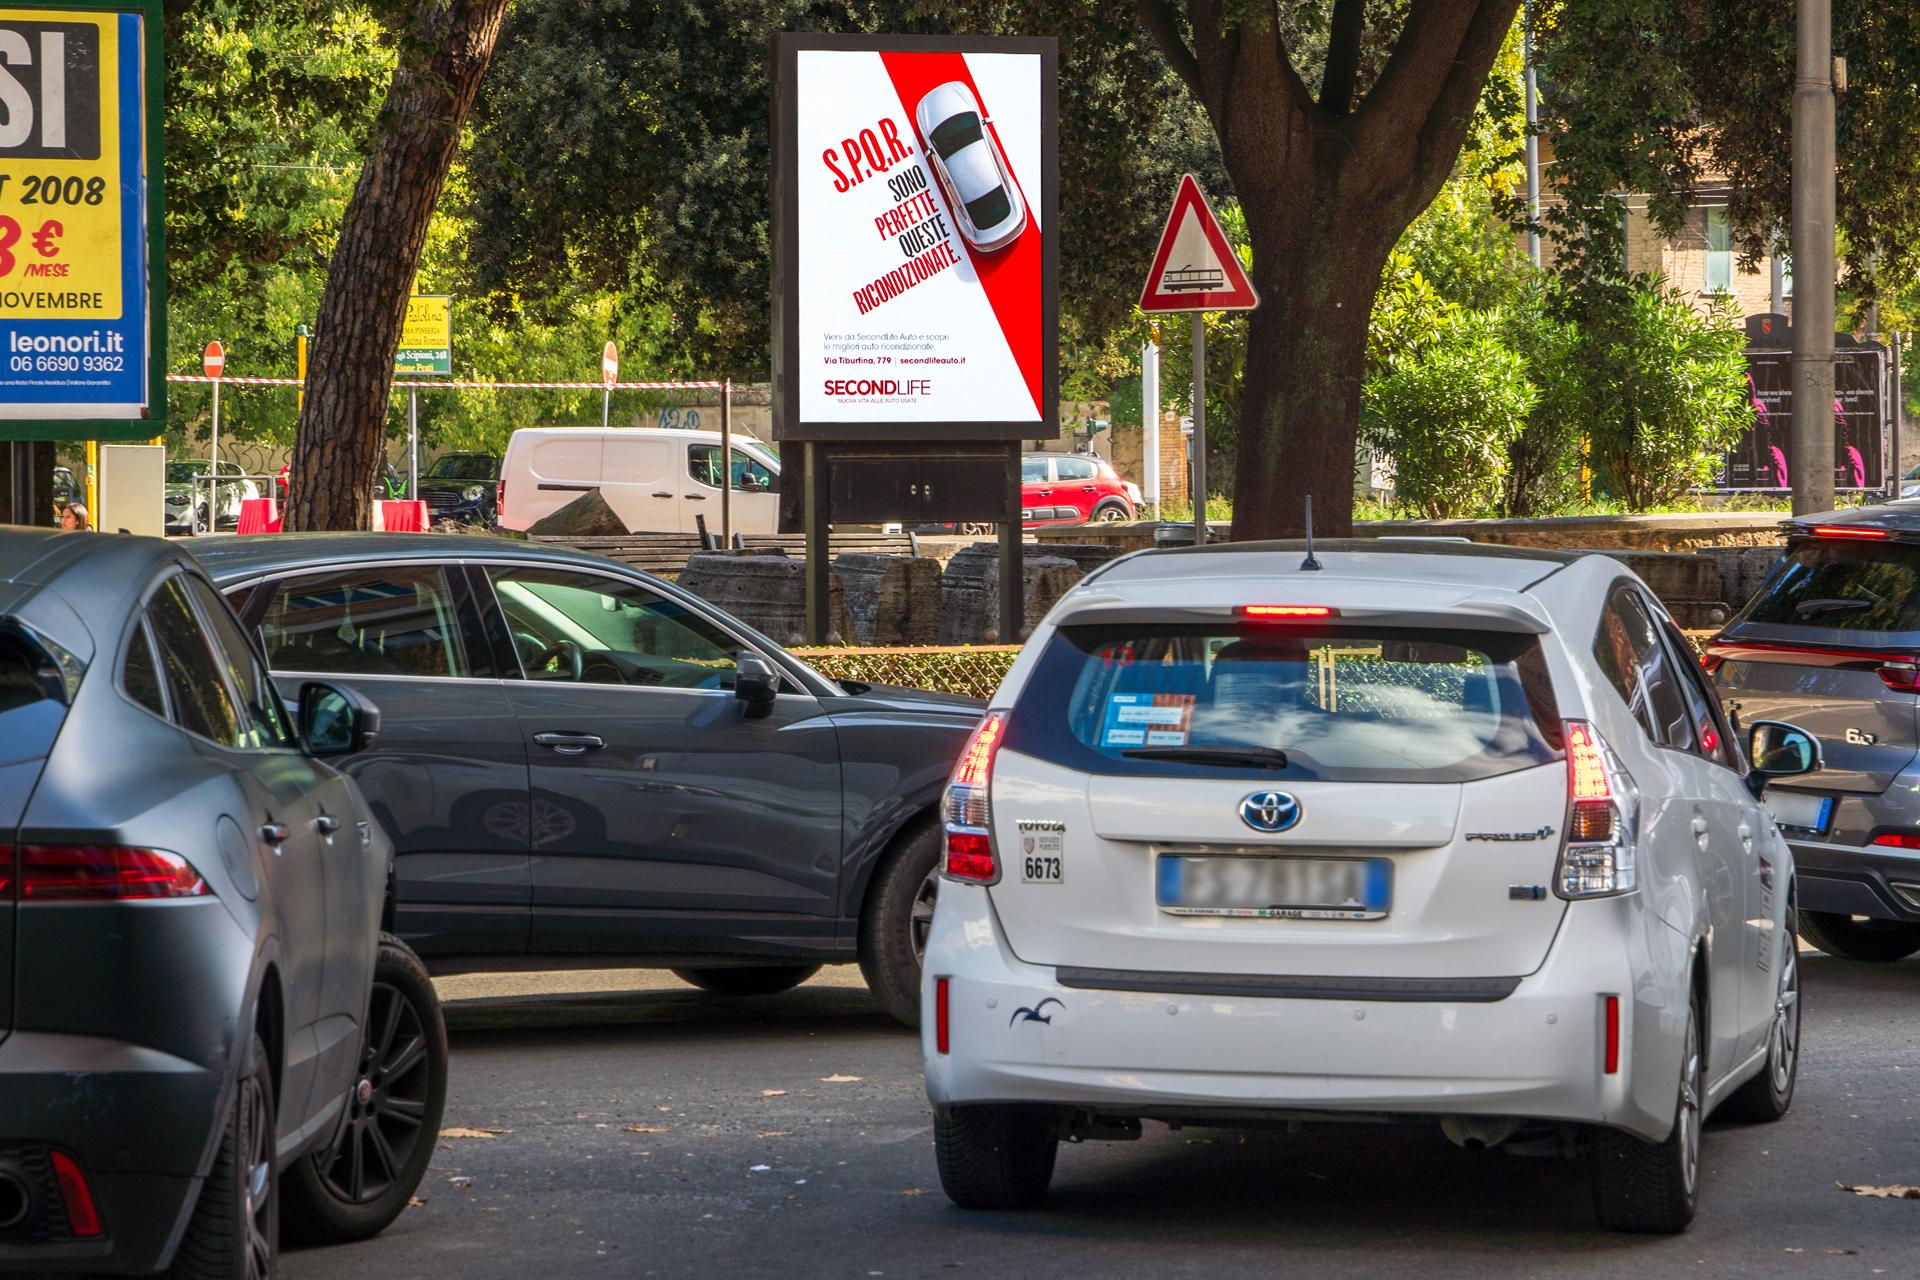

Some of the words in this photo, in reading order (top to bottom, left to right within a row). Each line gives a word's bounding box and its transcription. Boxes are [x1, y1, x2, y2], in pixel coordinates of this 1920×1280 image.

[822, 117, 915, 193] S.P.Q.R.
[20, 175, 106, 206] 2008
[887, 164, 927, 202] SONO
[874, 188, 939, 241] PERFETTE
[31, 219, 64, 257] €
[898, 213, 950, 258] QUESTE
[23, 263, 71, 277] /MESE
[852, 239, 962, 315] RICONDIZIONATE.
[0, 292, 103, 309] OVEMBRE
[10, 330, 124, 353] leonori.it
[899, 333, 917, 341] Auto
[832, 343, 860, 352] migliori
[10, 356, 33, 372] 06
[36, 356, 79, 372] 6690
[82, 356, 124, 372] 9362
[838, 357, 876, 365] Tiburtina,
[824, 379, 931, 396] SECONDLIFE
[1017, 819, 1066, 832] TOYOTA
[1025, 857, 1061, 879] 6673
[1258, 910, 1303, 919] M-GARAGE
